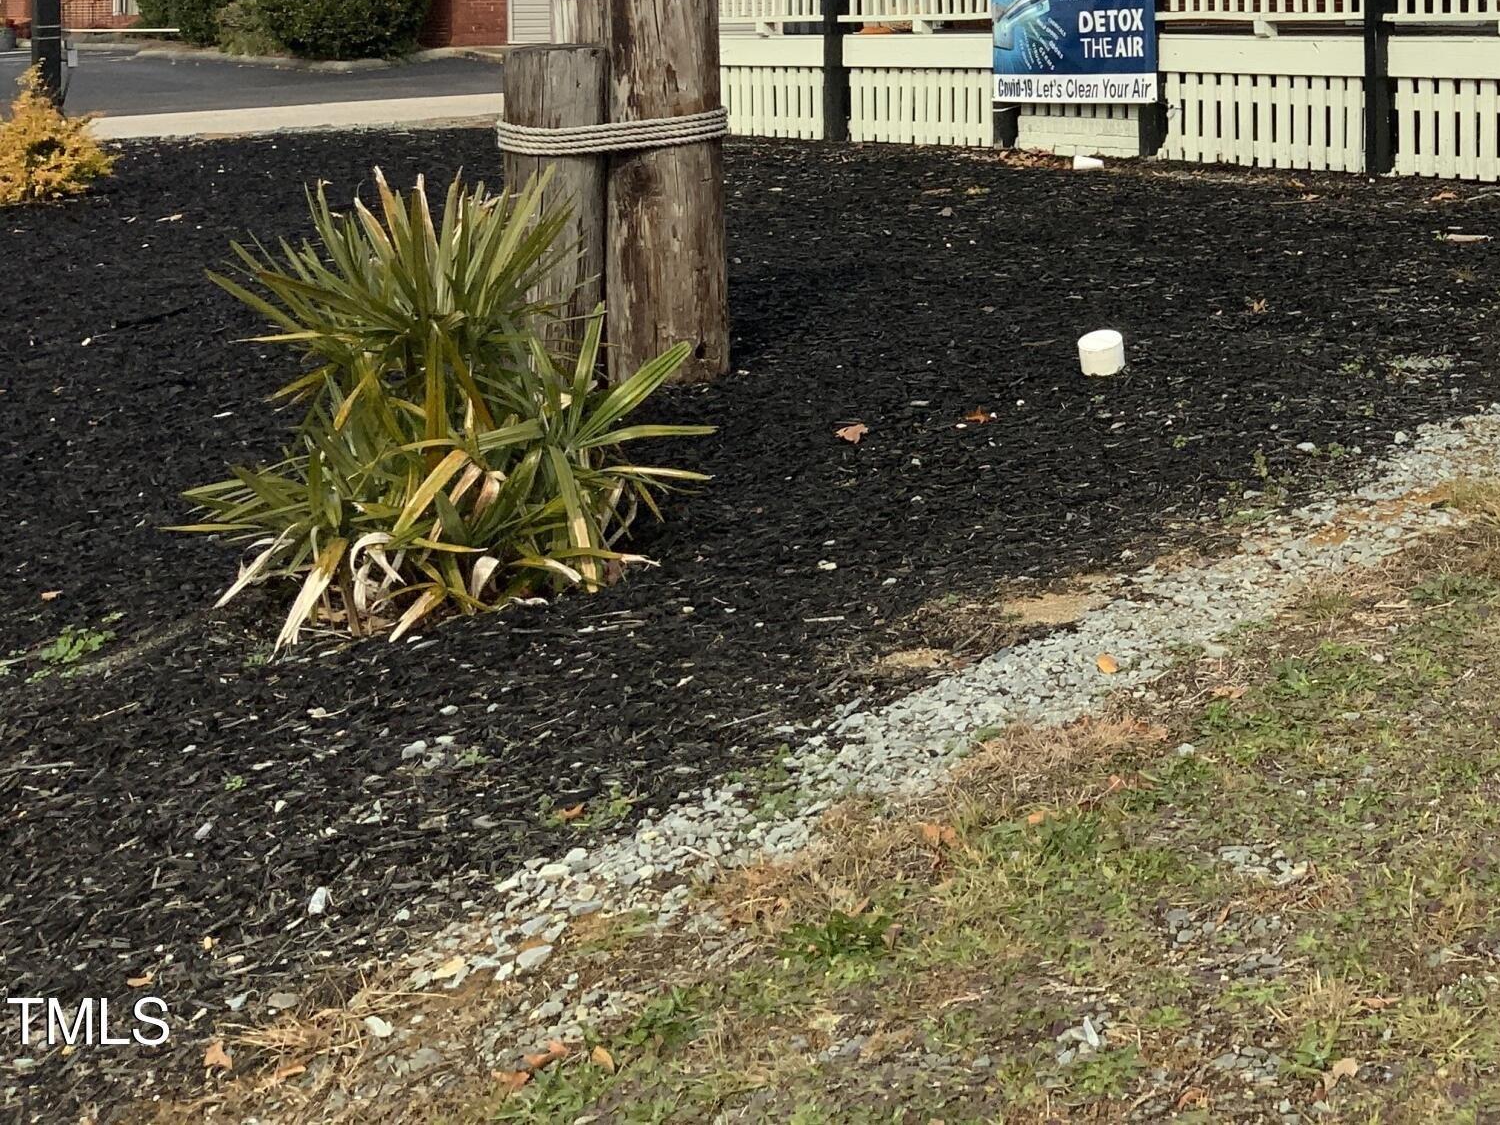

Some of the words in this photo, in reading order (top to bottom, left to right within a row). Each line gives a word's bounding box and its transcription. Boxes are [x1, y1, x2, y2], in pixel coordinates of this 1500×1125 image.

[1078, 8, 1144, 34] DETOX
[1080, 37, 1113, 58] THE
[1114, 35, 1144, 58] AIR
[998, 78, 1033, 98] Covid-19
[1036, 78, 1062, 98] Let's
[1065, 78, 1099, 98] Clean
[1103, 78, 1129, 98] Your
[1131, 78, 1152, 98] Air
